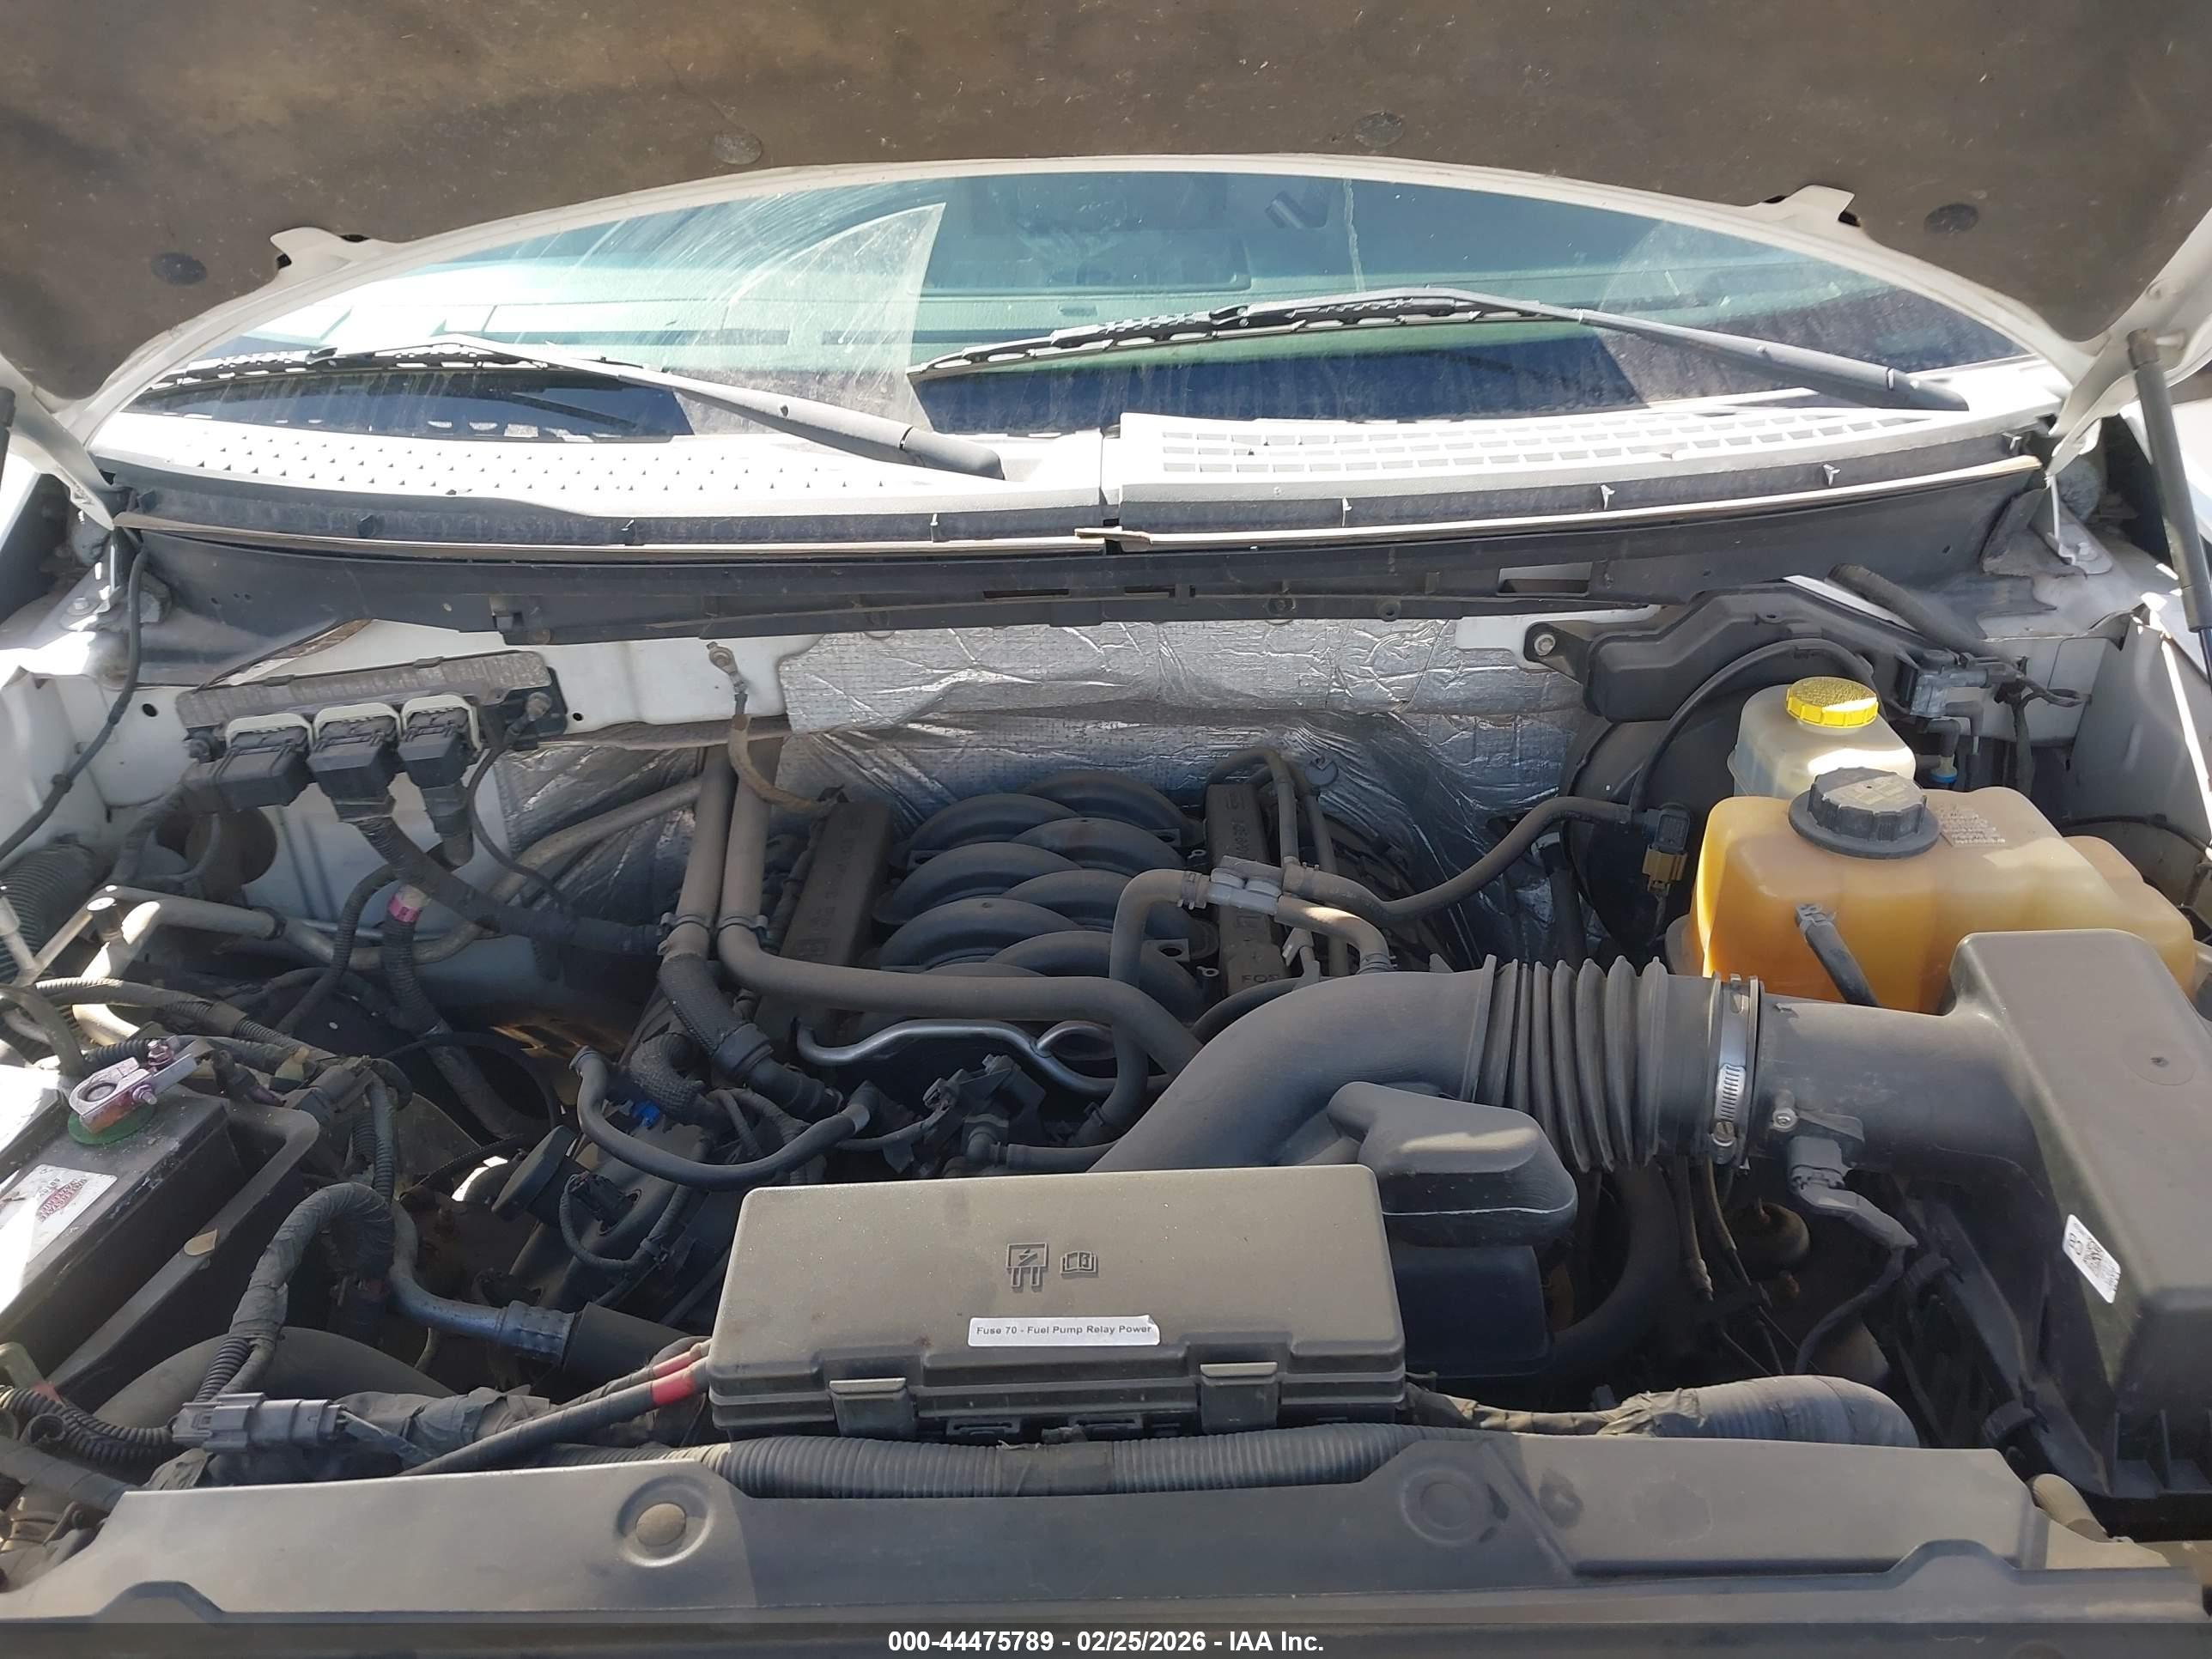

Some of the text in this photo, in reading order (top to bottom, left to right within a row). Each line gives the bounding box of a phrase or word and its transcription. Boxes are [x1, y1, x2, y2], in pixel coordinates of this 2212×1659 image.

[975, 1326, 1002, 1335] Fuse
[1006, 1326, 1018, 1334] 70
[1027, 1326, 1049, 1334] Fuel
[1053, 1326, 1083, 1335] Pump
[1086, 1325, 1115, 1335] Relay
[1118, 1325, 1152, 1334] Power
